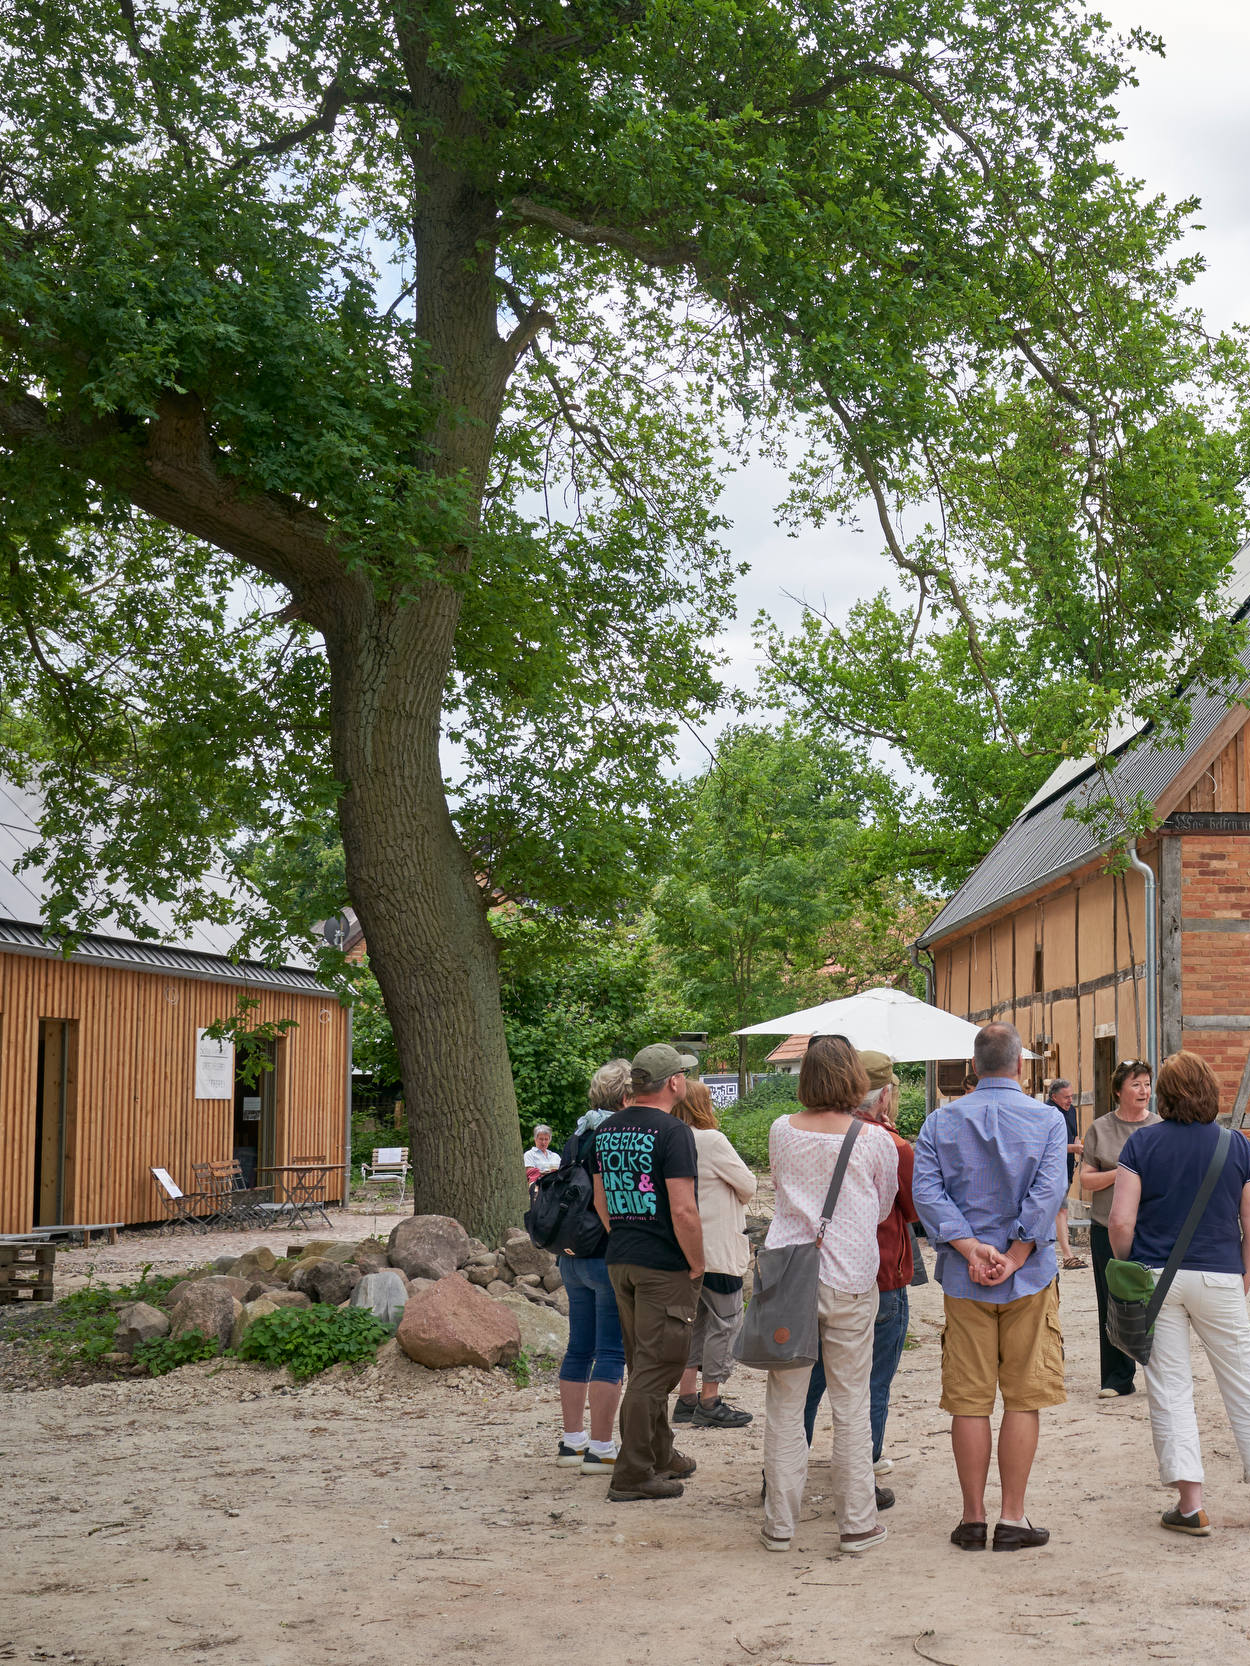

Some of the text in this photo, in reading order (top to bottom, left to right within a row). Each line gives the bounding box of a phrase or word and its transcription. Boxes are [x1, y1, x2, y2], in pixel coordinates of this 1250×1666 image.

[596, 1132, 656, 1152] FREAKS
[601, 1151, 653, 1173] FOLKS
[602, 1171, 656, 1192] ANS &
